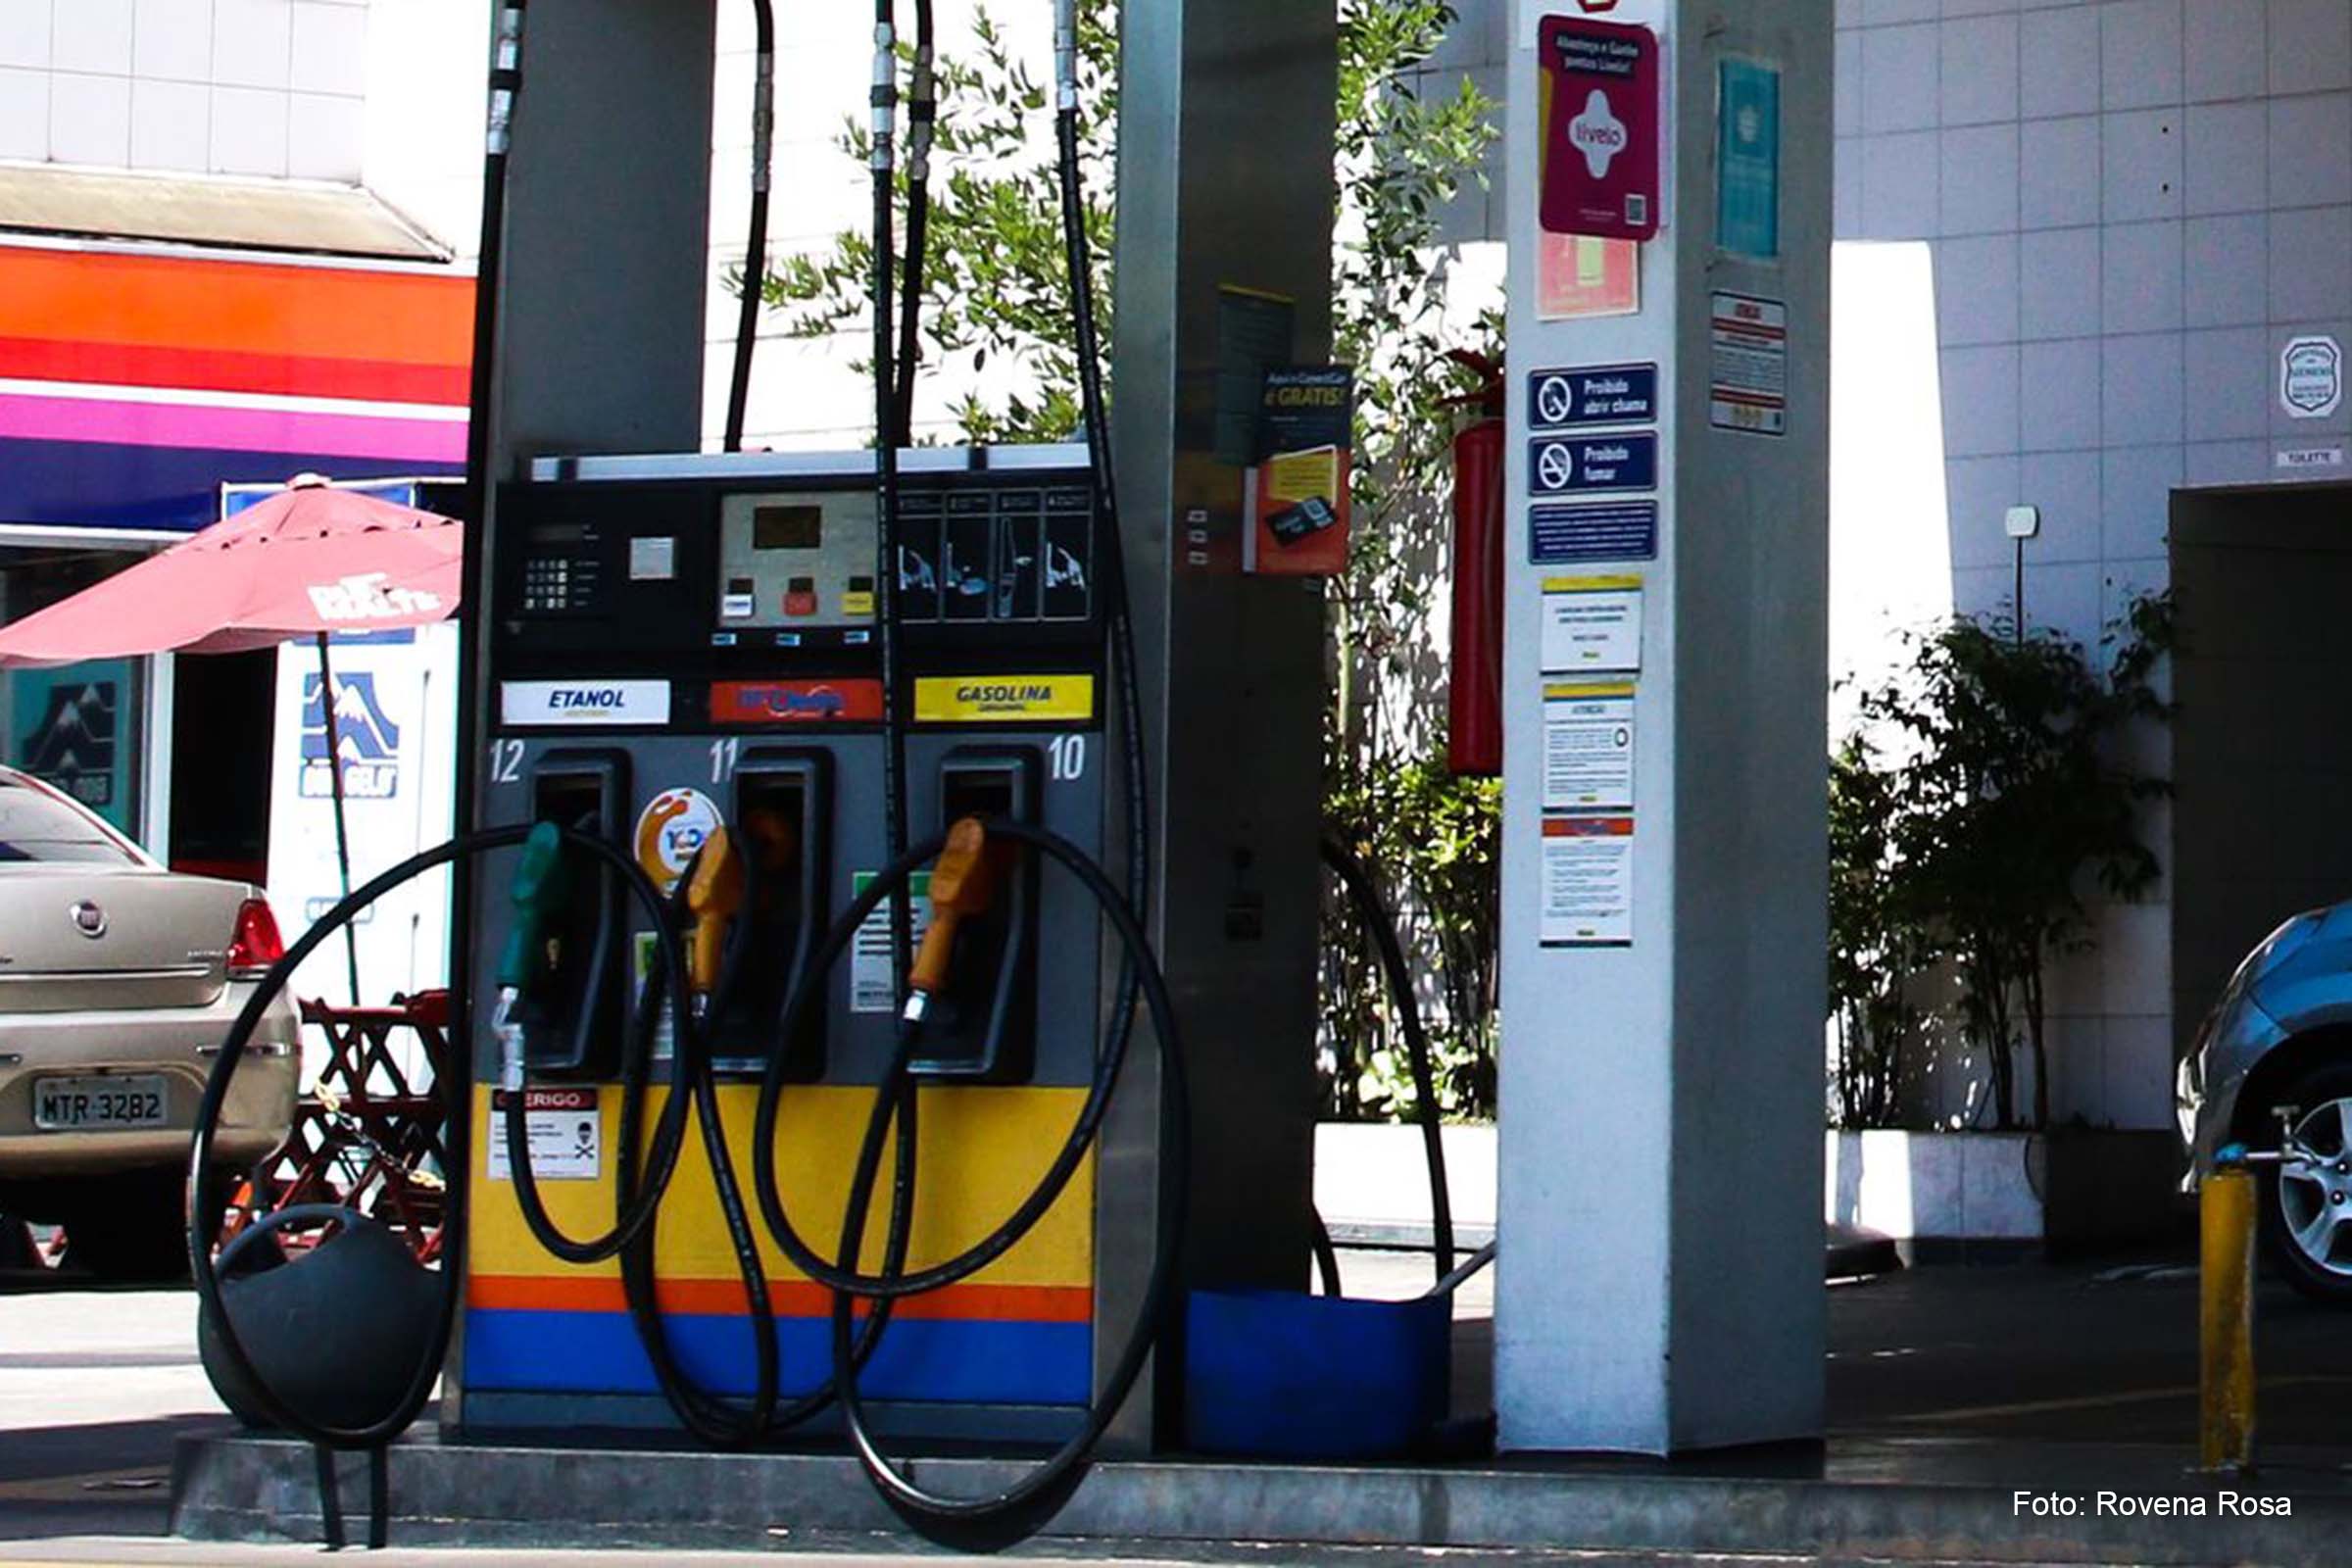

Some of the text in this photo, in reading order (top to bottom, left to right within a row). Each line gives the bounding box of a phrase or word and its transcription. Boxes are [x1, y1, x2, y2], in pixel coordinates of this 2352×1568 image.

[1585, 378, 1629, 395] Proibido
[1585, 398, 1646, 416] abrir chama
[1585, 446, 1629, 462] Proibido
[1585, 466, 1616, 481] fumar
[549, 690, 625, 709] ETANOL
[956, 685, 1052, 703] GASOLINA
[491, 738, 525, 783] 12
[710, 737, 739, 784] 11
[1049, 735, 1085, 780] 10
[524, 1092, 581, 1108] ERIGO
